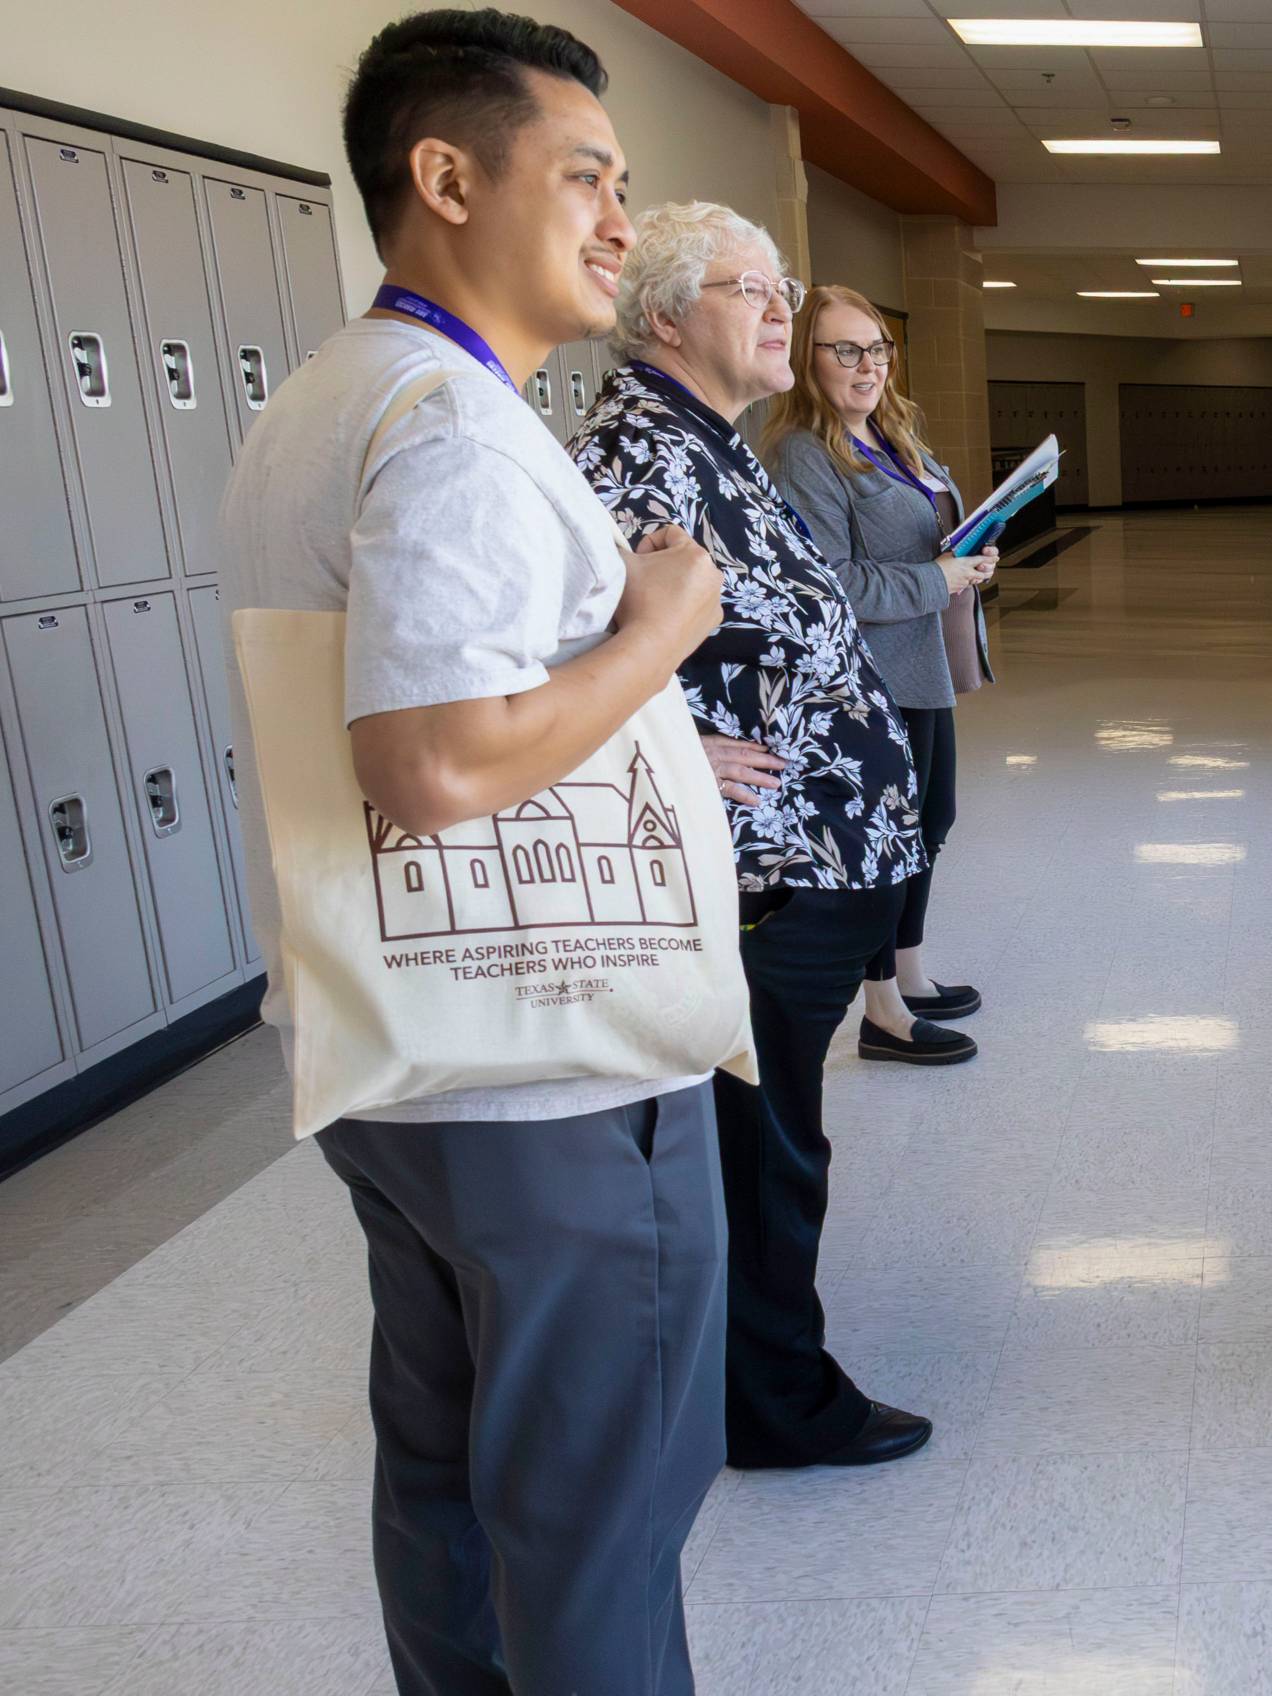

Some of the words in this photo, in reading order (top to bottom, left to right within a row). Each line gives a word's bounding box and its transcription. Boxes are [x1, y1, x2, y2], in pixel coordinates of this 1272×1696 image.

[383, 949, 457, 969] WHERE
[461, 941, 548, 962] ASPIRING
[552, 937, 635, 953] TEACHERS
[639, 938, 703, 951] BECOME
[450, 959, 547, 981] TEACHERS
[552, 955, 597, 971] WHO
[601, 954, 660, 968] INSPIRE
[515, 982, 555, 996] TEXAS
[572, 979, 609, 989] STATE
[531, 993, 594, 1008] UNIVERSITY
